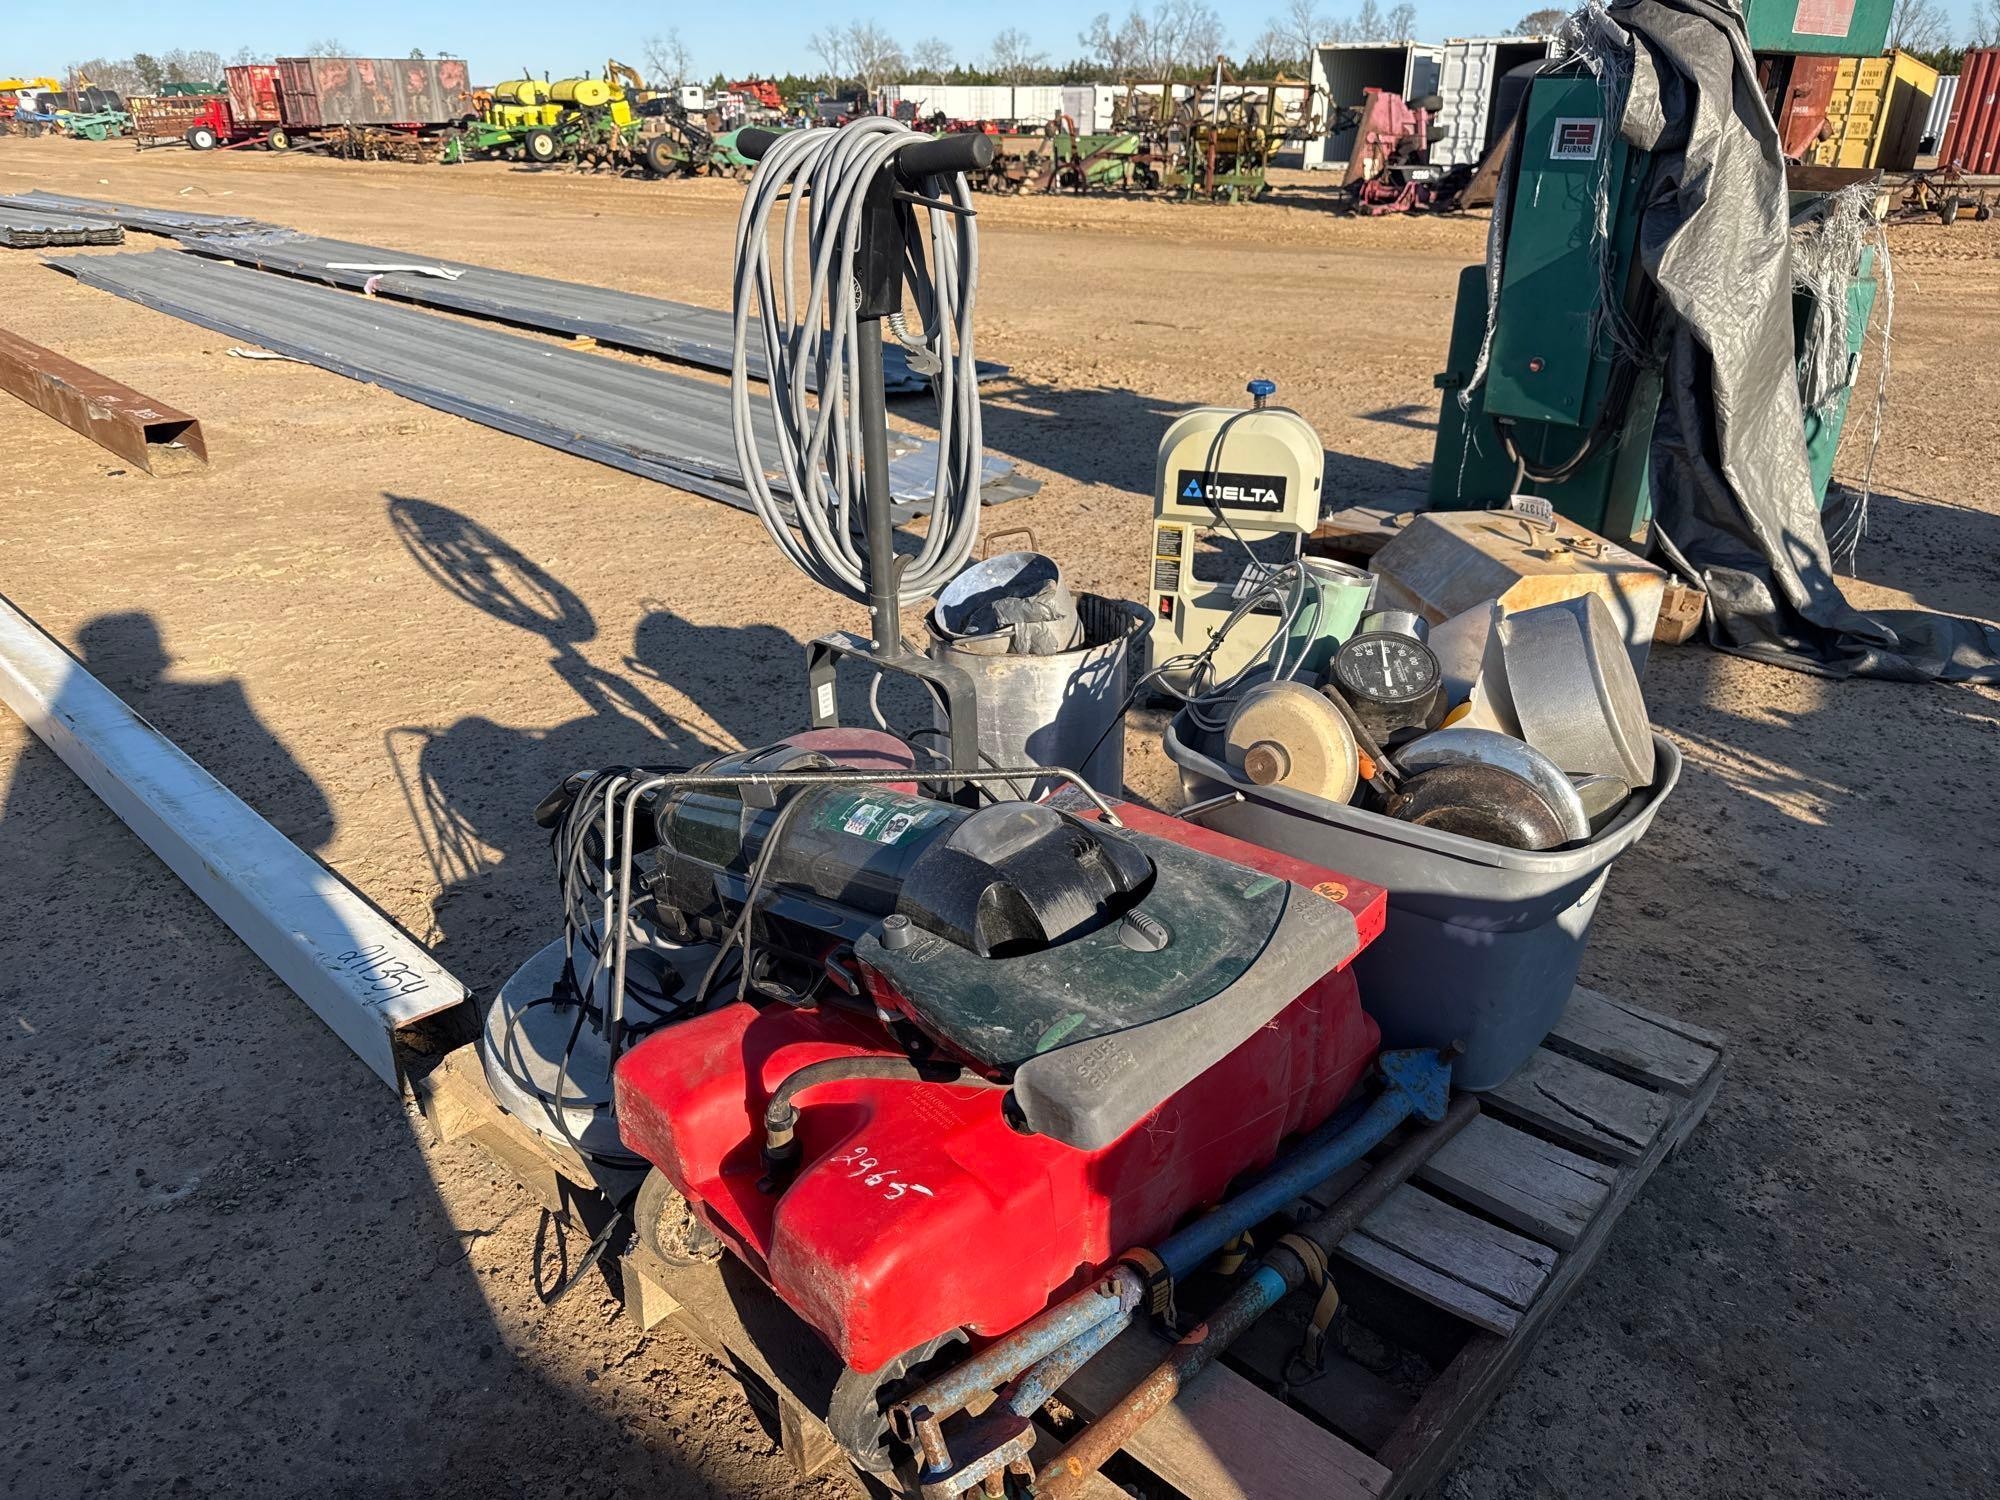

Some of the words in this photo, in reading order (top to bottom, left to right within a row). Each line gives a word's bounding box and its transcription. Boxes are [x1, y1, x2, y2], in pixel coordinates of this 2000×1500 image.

[1563, 145, 1592, 153] FURNAS
[1205, 485, 1279, 504] DELTA
[337, 944, 430, 1006] 211354
[1075, 1037, 1117, 1079] SCUFF
[830, 1146, 935, 1200] 2965
